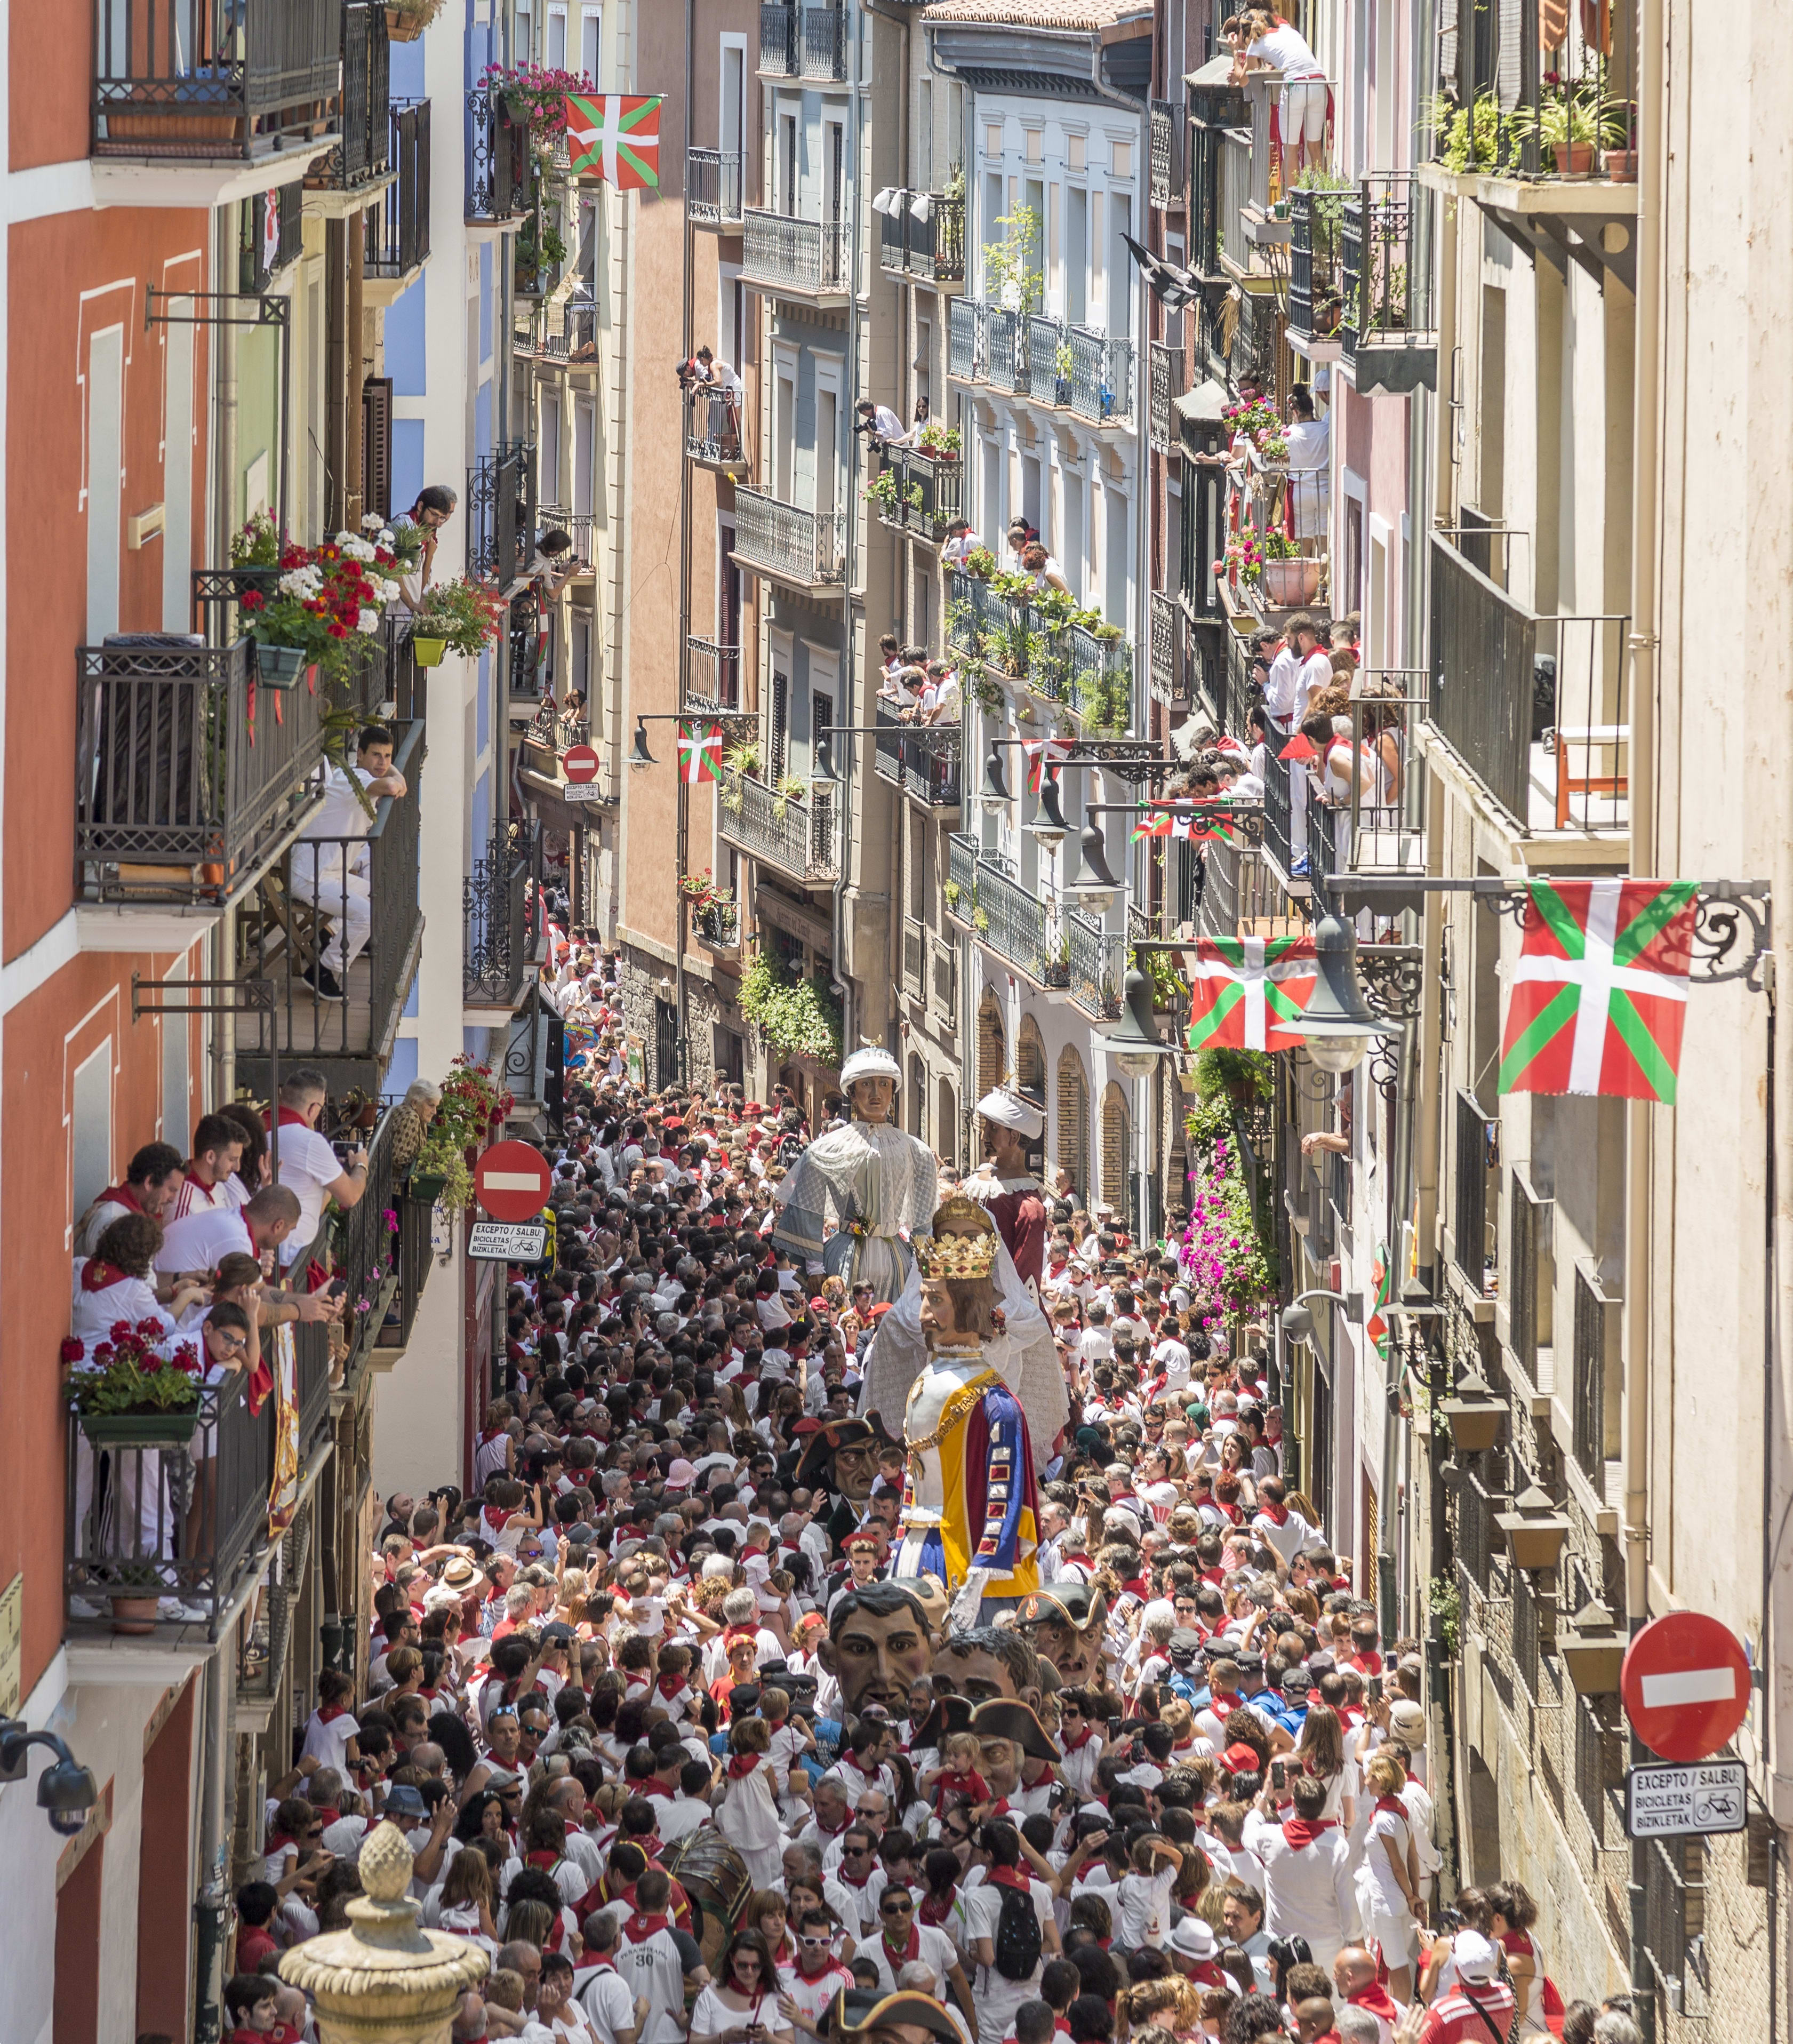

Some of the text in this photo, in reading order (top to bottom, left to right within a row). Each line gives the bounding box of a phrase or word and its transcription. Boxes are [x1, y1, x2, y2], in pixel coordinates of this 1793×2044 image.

[476, 1225, 509, 1234] EXCEPTO
[516, 1227, 542, 1237] SALBU:
[473, 1235, 510, 1244] BICICLETAS
[472, 1245, 507, 1254] BIZIKLETAK
[1637, 1772, 1688, 1791] EXCEPTO
[1699, 1768, 1740, 1785] SALBU:
[1635, 1792, 1692, 1809] BICICLETAS
[1637, 1812, 1691, 1829] BIZIKLETAK
[636, 1954, 653, 1967] 30
